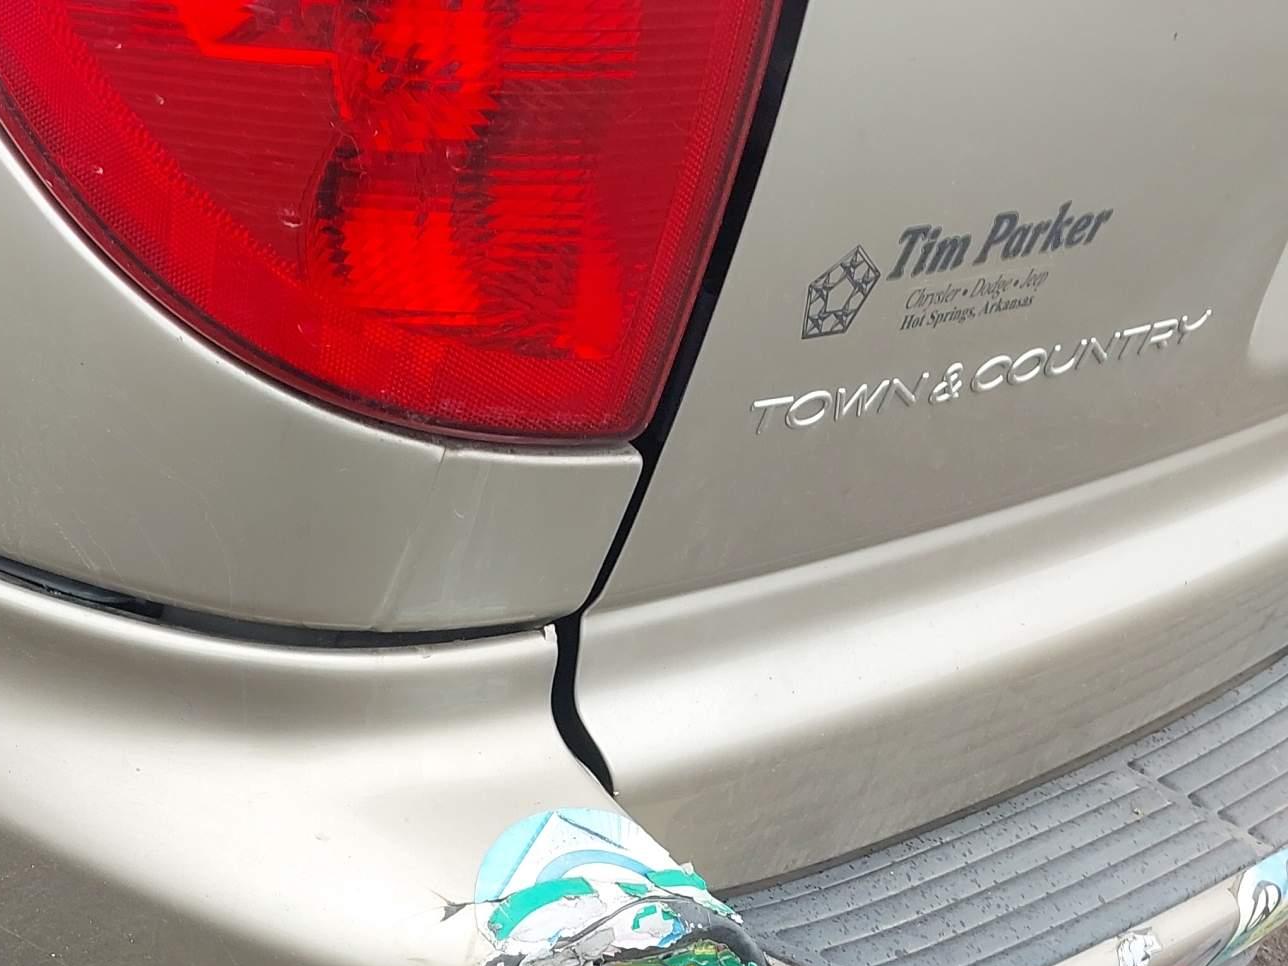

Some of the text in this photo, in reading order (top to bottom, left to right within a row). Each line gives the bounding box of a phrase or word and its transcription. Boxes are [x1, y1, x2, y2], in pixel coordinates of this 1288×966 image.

[886, 200, 1114, 281] Tim Parker
[899, 296, 1034, 331] Hot Springs, Arkansas
[905, 268, 1049, 312] Chrysler Dodge Jeep
[751, 307, 1213, 434] TOWN & COUNTRY
